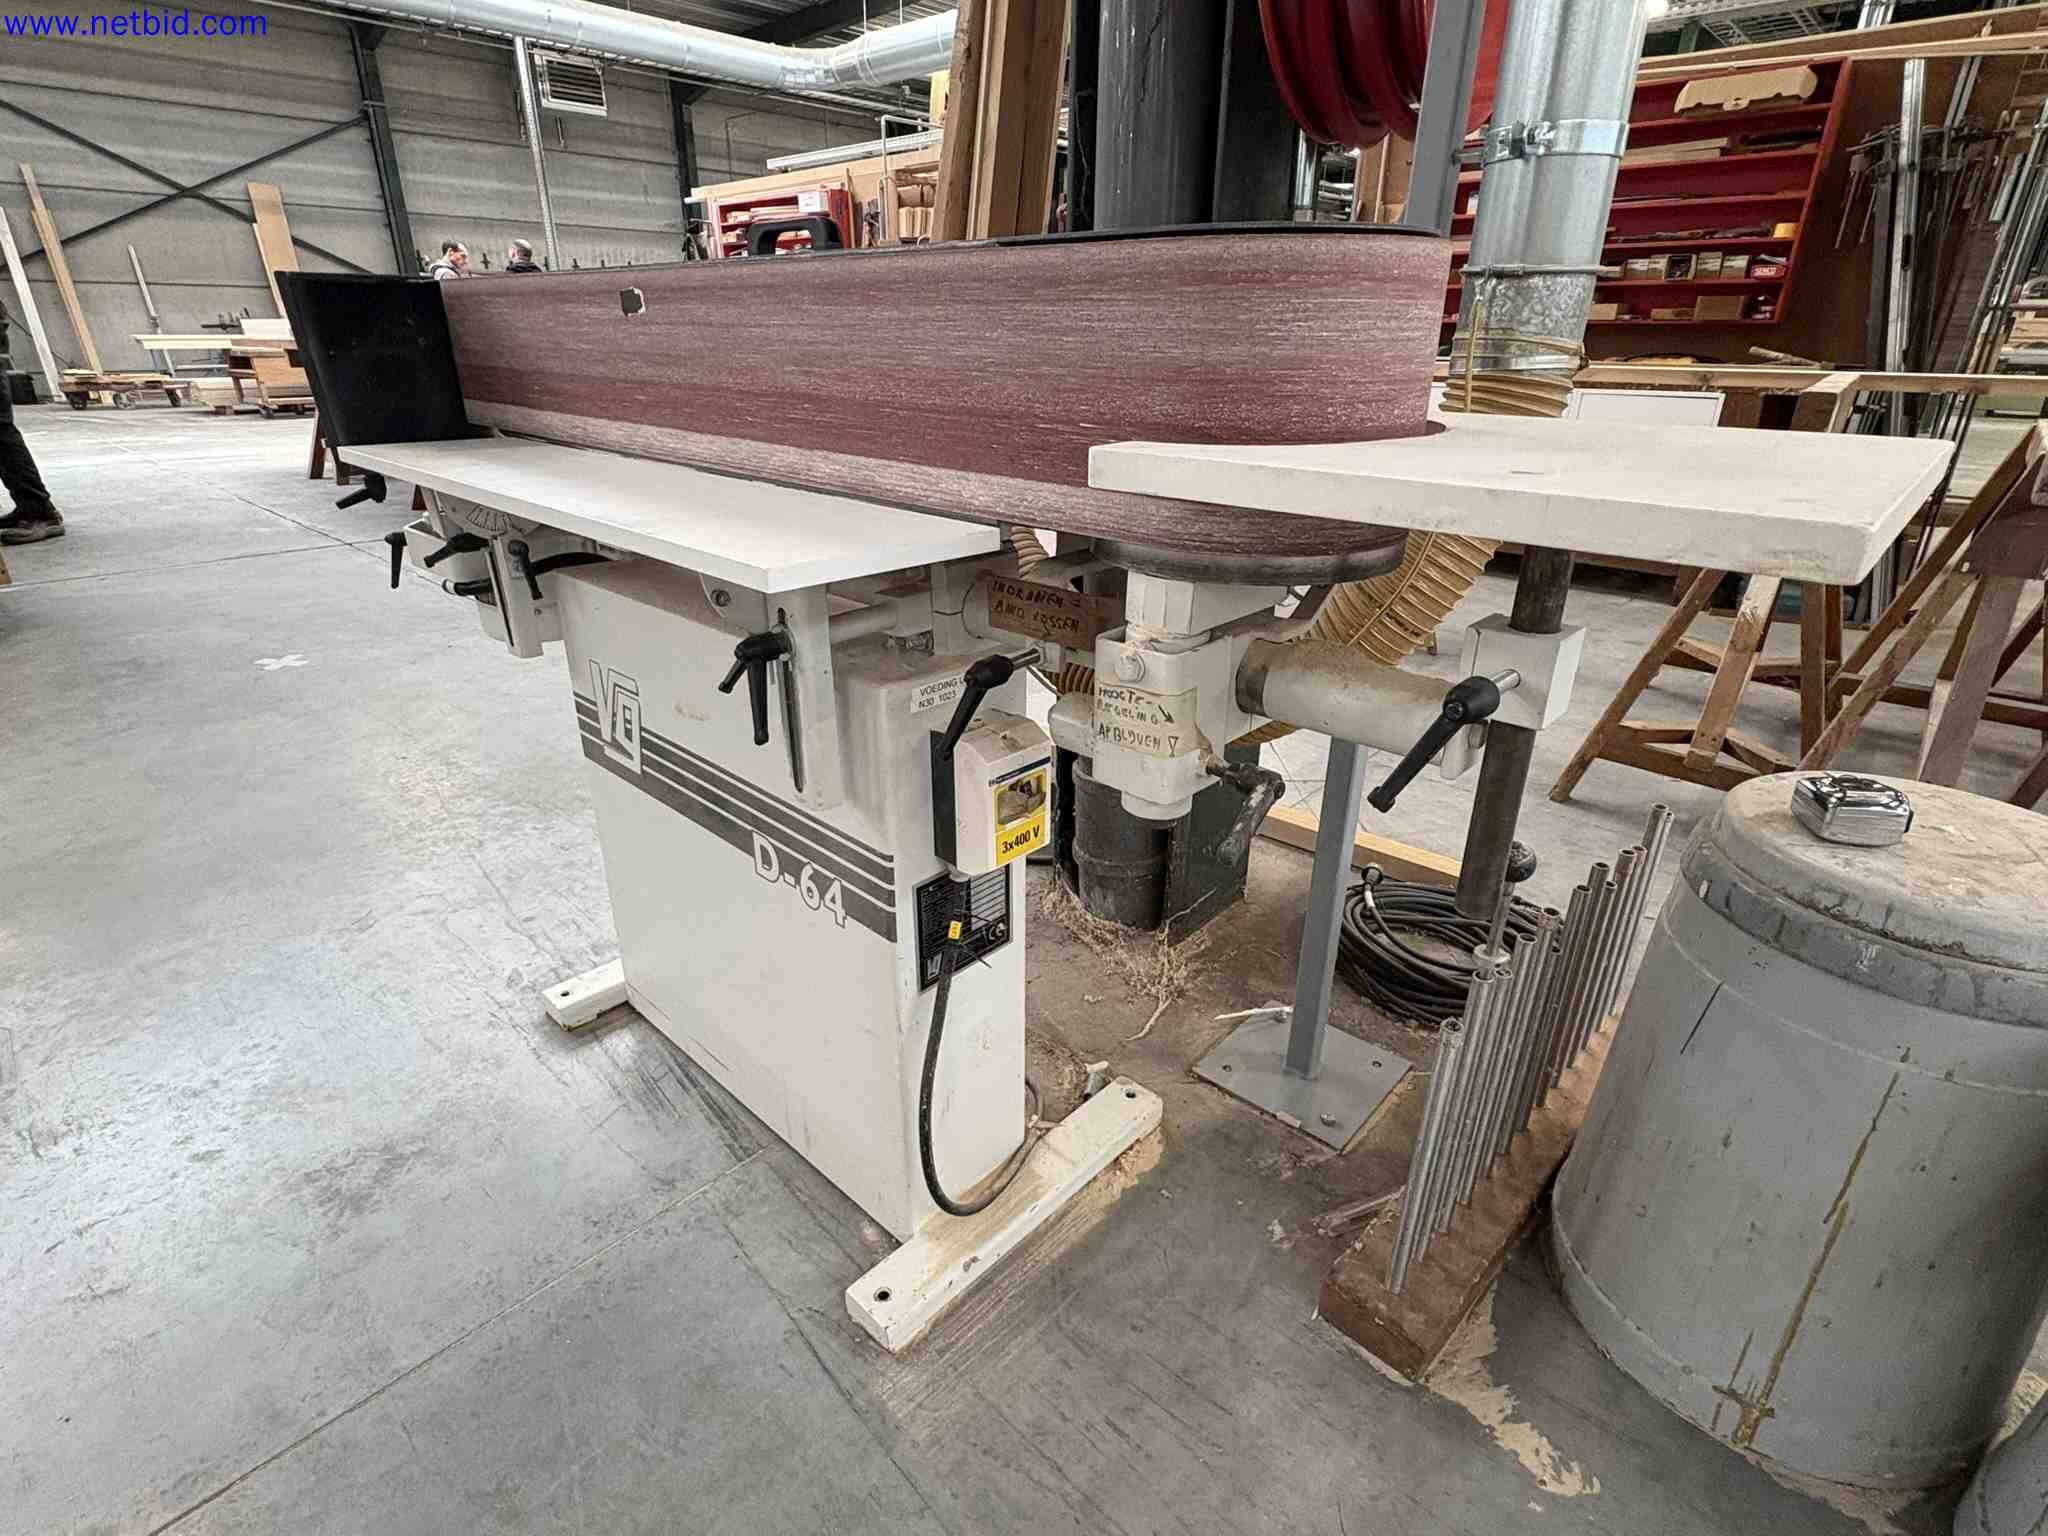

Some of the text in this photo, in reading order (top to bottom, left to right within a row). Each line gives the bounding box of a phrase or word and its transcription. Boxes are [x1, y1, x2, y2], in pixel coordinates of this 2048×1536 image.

[920, 678, 957, 696] VOEDING
[1001, 824, 1040, 854] 3x400 V
[752, 830, 848, 929] D-64
